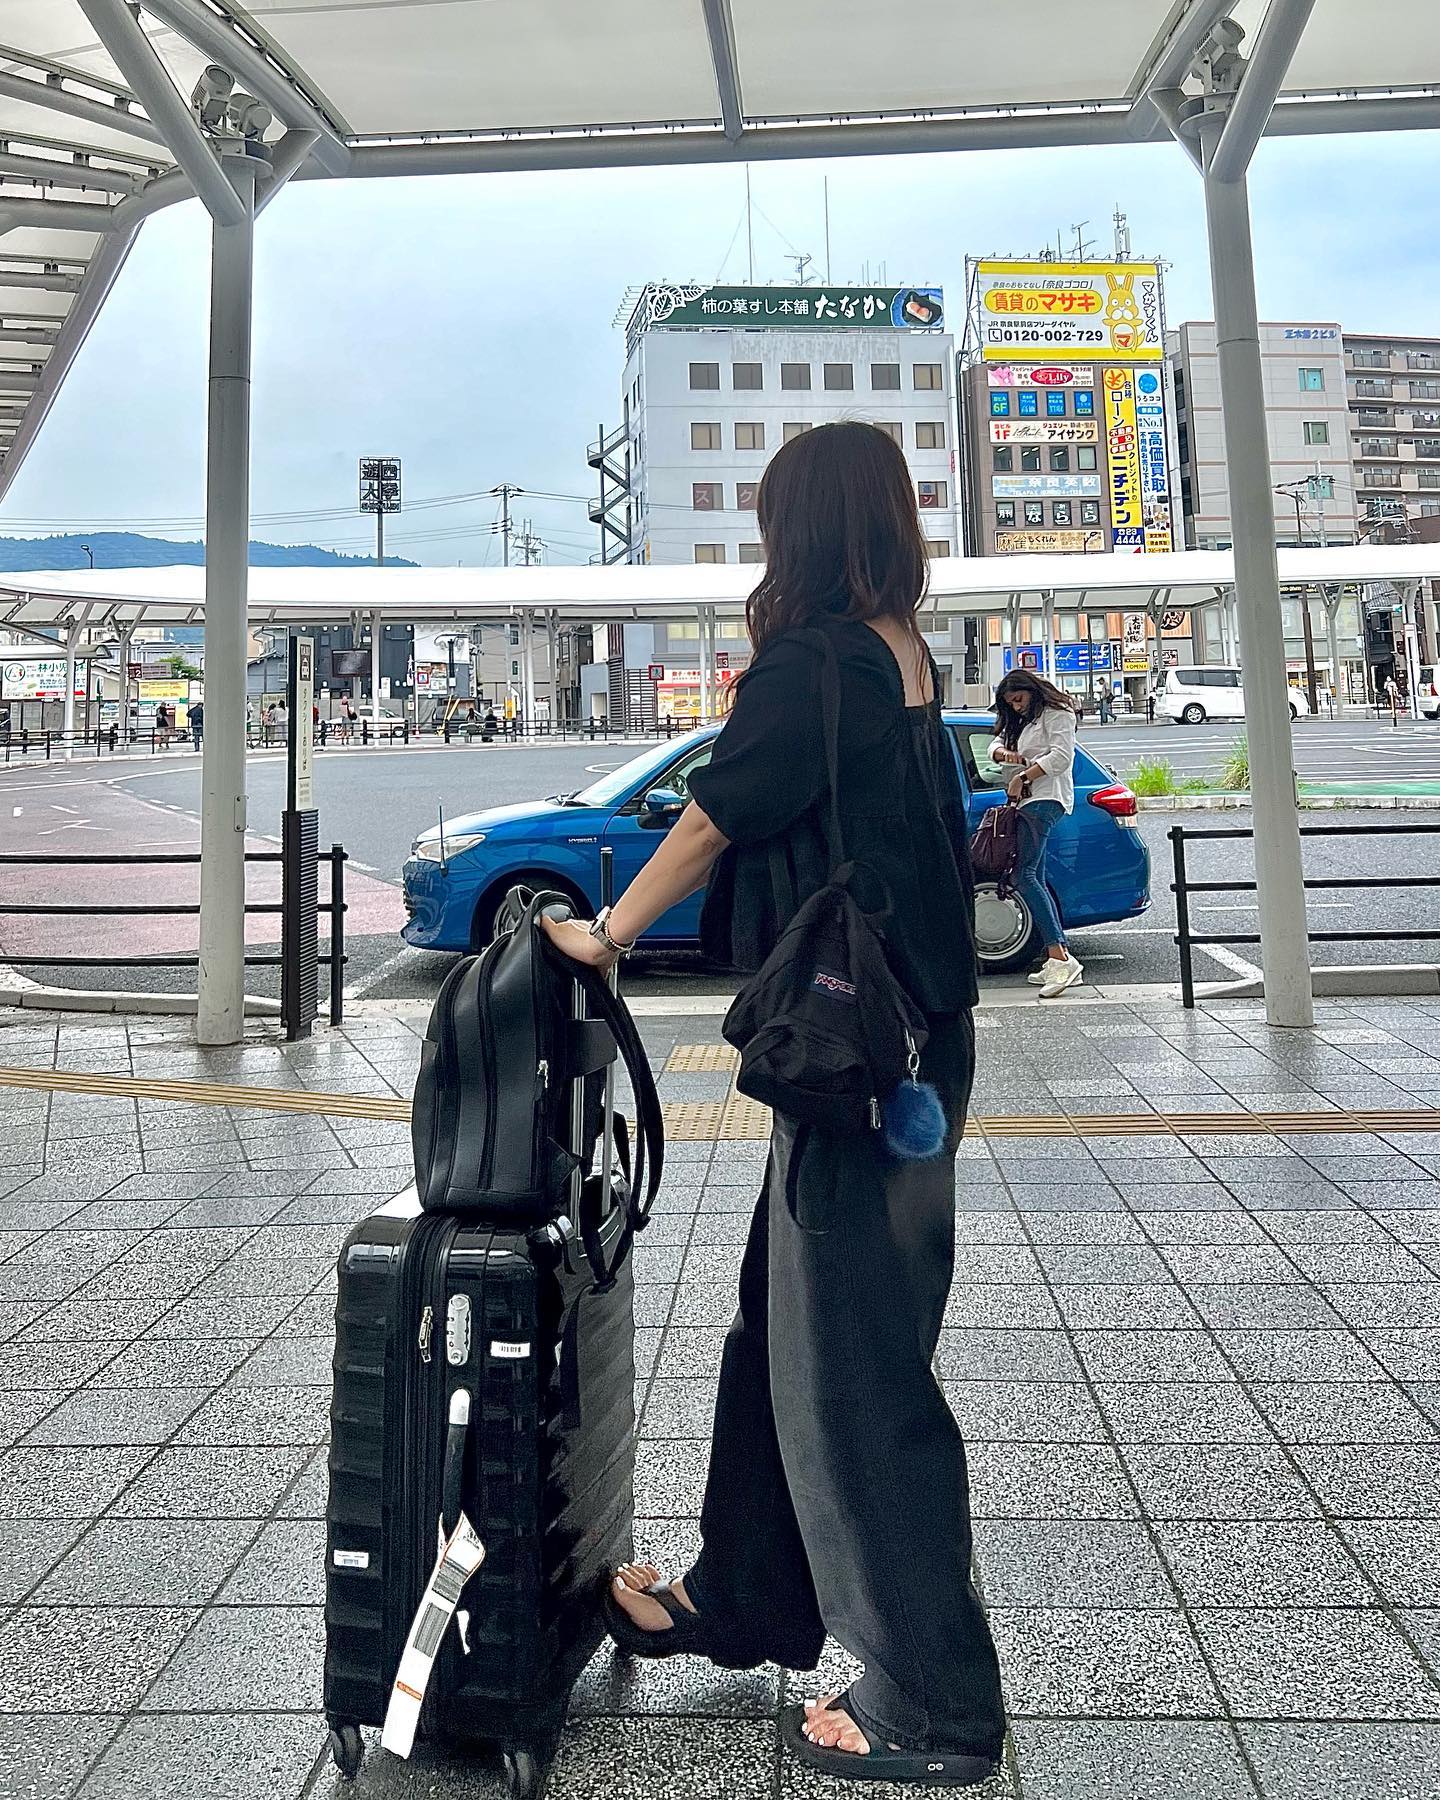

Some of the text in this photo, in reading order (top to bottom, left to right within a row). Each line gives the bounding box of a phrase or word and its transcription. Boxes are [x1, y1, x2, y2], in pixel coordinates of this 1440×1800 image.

[701, 293, 887, 319] 柿の葉すし本舗 たなか
[992, 293, 1096, 312] 賃貸のマサキ
[1004, 330, 1104, 341] 0120-002-729
[993, 403, 1008, 413] 6F
[1112, 391, 1125, 428] ローン
[995, 430, 1011, 440] 1F
[1048, 430, 1094, 440] アイサンク
[1148, 431, 1166, 492] 高価買取
[696, 490, 710, 503] ス
[740, 490, 753, 503] ク
[1112, 456, 1131, 525] ニチデン
[1116, 535, 1142, 545] 4444
[722, 659, 728, 667] 3
